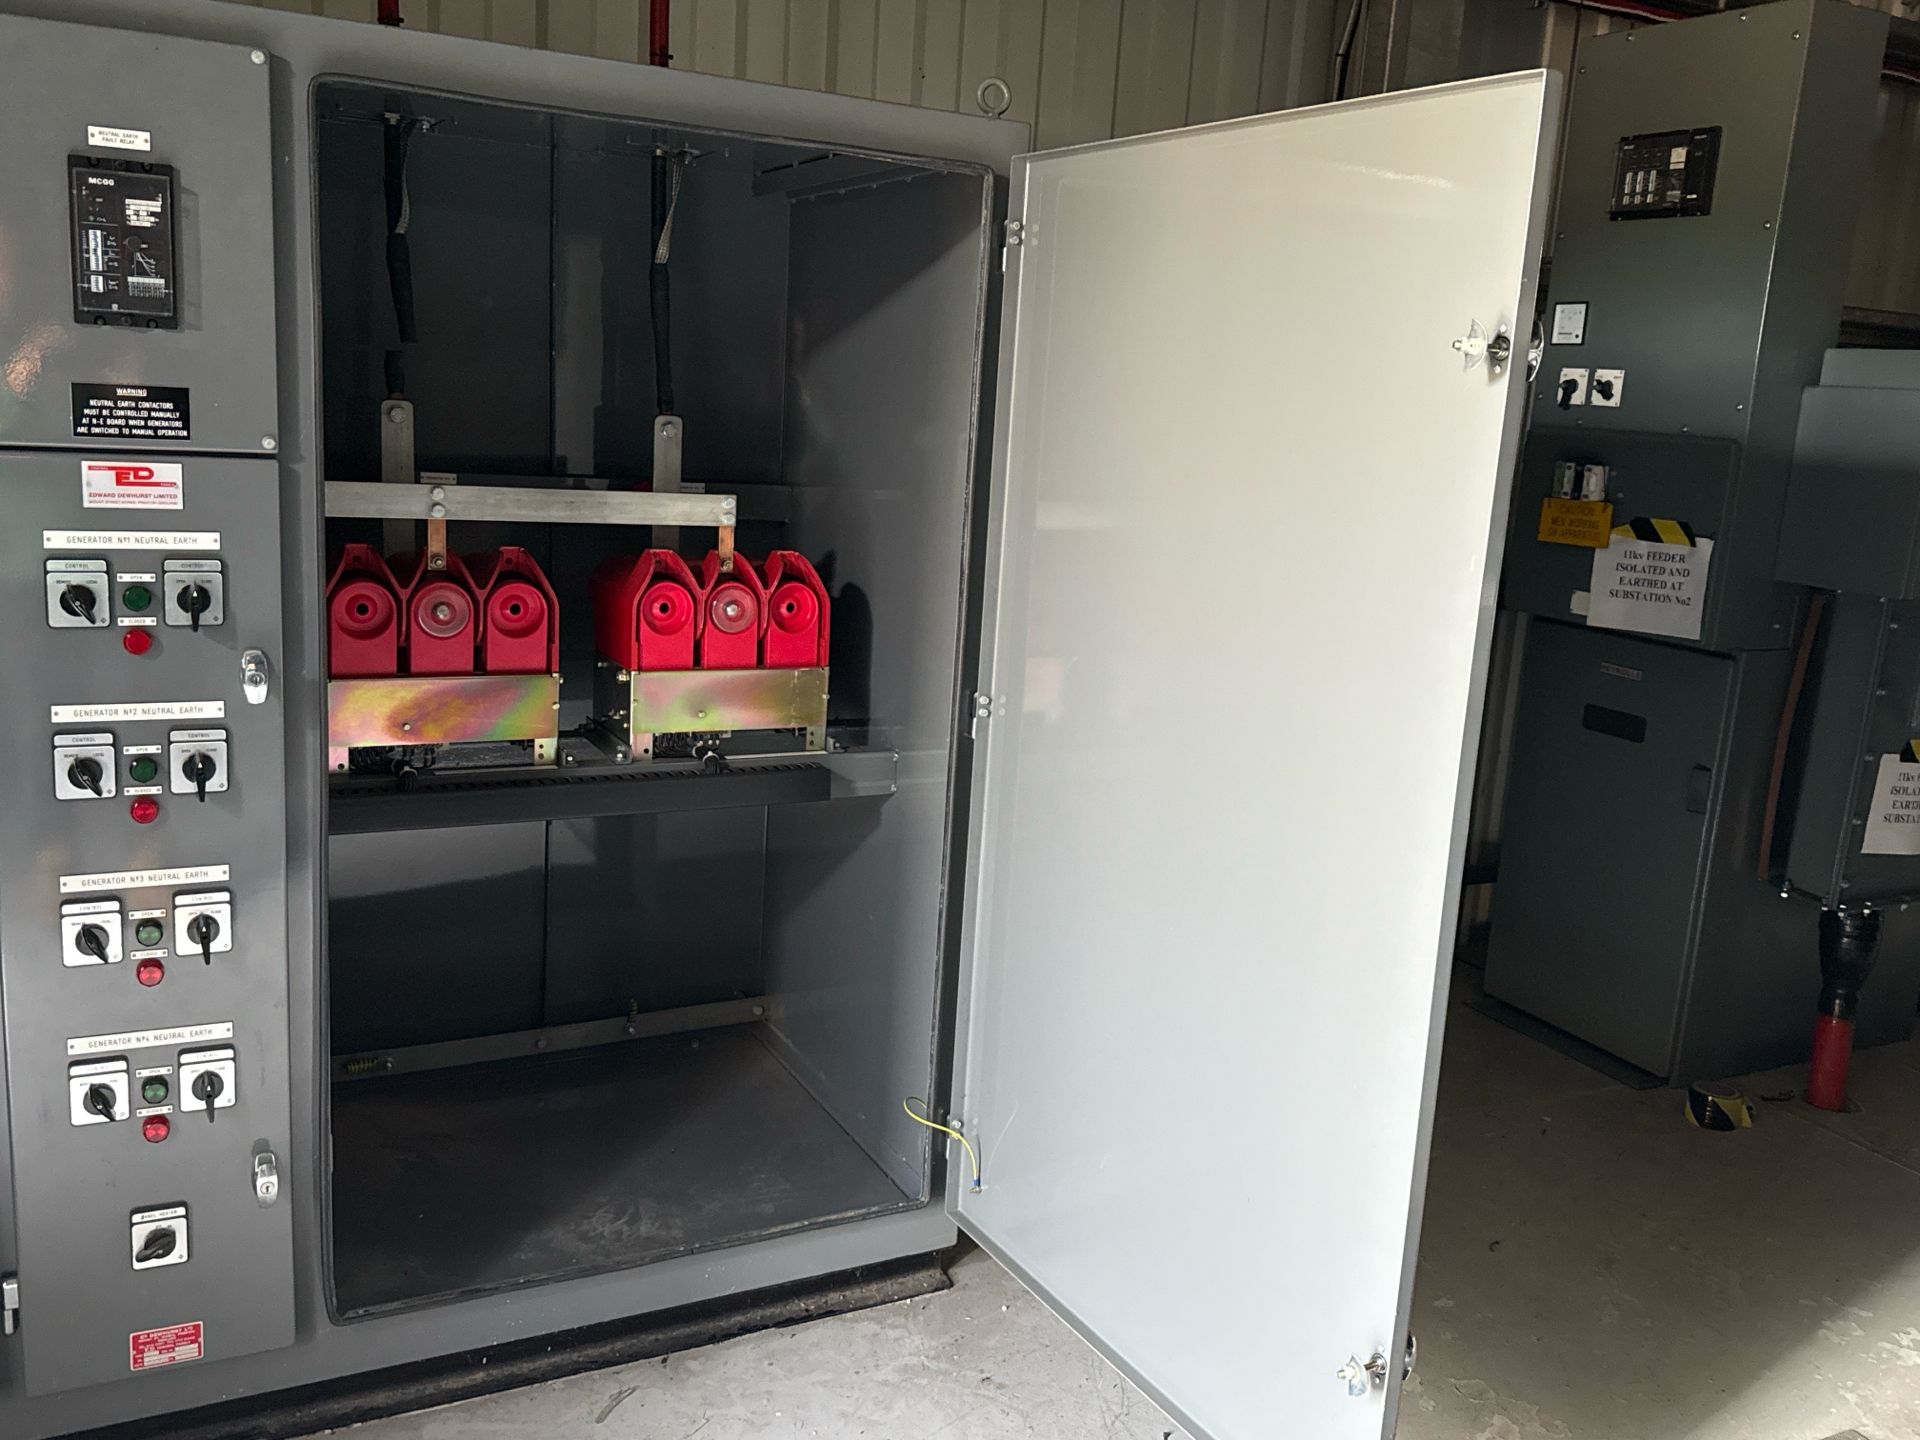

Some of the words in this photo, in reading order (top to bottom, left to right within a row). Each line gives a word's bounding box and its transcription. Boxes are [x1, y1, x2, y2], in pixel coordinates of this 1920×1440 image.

[89, 177, 115, 186] MCGG
[116, 388, 148, 397] WARNING
[90, 399, 115, 407] NEUTRAL
[118, 400, 136, 408] EARTH
[138, 401, 174, 410] CONTACTORS
[151, 411, 180, 419] MANUALLY
[148, 420, 183, 428] GENERATORS
[67, 536, 113, 544] GENERATOR
[135, 537, 170, 545] NEUTRAL
[174, 537, 198, 545] EARTH
[1647, 552, 1686, 564] FEEDER
[1616, 562, 1666, 576] ISOLATED
[1669, 568, 1690, 578] AND
[1618, 576, 1667, 590] EARTHED
[1670, 582, 1685, 591] AT
[1609, 589, 1673, 604] SUBSTATION
[1675, 597, 1692, 607] No2
[74, 709, 119, 718] GENERATOR
[142, 707, 175, 715] NEUTRAL
[179, 706, 204, 714] EARTH
[82, 877, 126, 887] GENERATOR
[148, 873, 181, 882] NEUTRAL
[185, 871, 209, 879] EARTH
[88, 1038, 132, 1049] GENERATOR
[154, 1032, 185, 1041] NEUTRAL
[190, 1029, 213, 1038] EARTH
